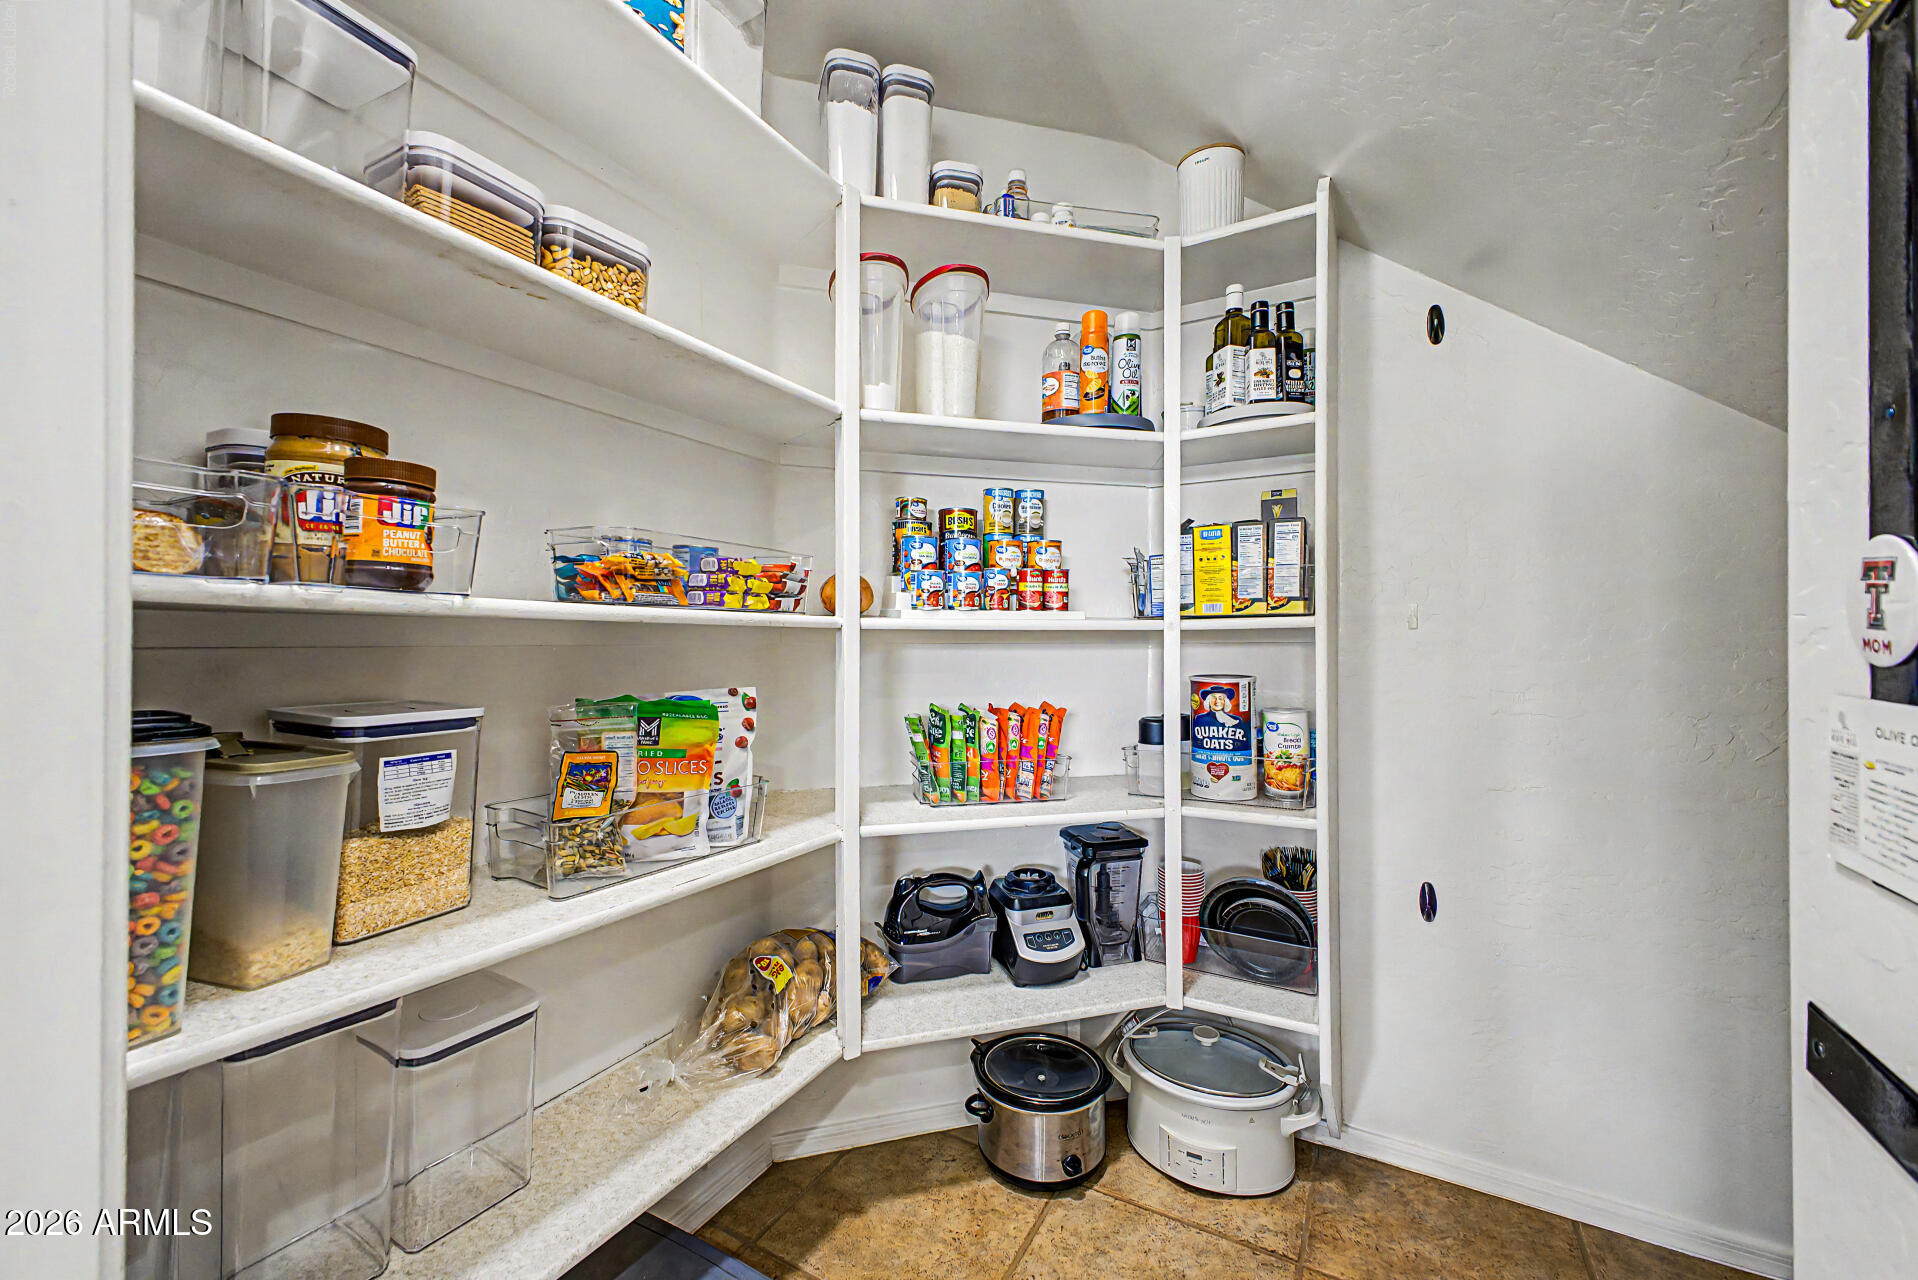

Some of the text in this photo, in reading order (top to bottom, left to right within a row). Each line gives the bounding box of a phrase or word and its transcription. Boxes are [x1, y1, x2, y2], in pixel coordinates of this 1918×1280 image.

[291, 473, 346, 485] NATUR
[382, 502, 428, 526] Jif
[383, 529, 422, 540] PEANUT
[383, 538, 420, 549] BUTTER
[382, 547, 428, 558] CHOCOLATE
[1862, 637, 1893, 655] MOM
[1875, 726, 1906, 745] OLIVE
[1203, 737, 1234, 750] OATS
[655, 759, 708, 775] SLICES
